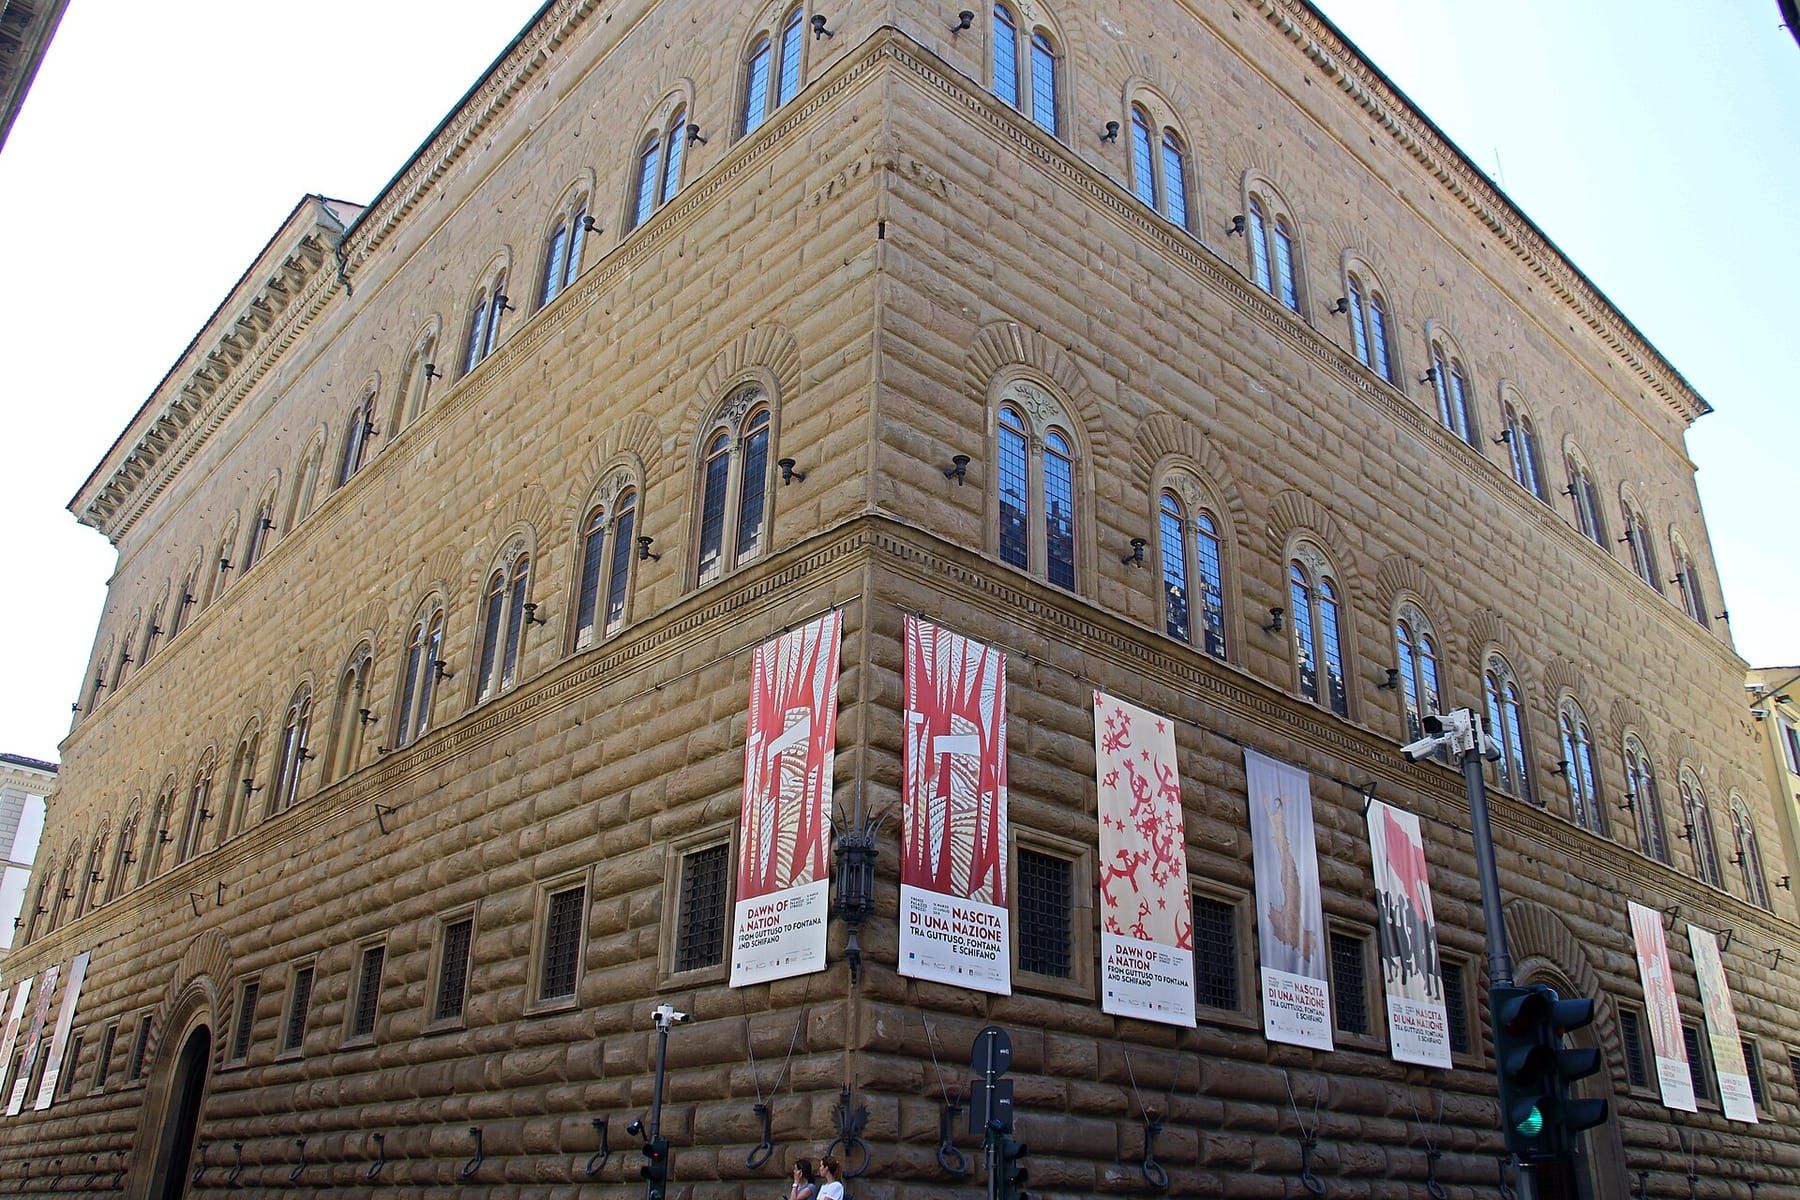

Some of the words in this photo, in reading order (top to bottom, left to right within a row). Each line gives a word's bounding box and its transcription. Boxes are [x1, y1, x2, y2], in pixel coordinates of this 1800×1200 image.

[747, 903, 774, 919] DAWN
[776, 900, 789, 912] OF
[952, 907, 1001, 928] NASCITA
[738, 931, 755, 942] FROM
[755, 926, 782, 938] GUTTUSO
[784, 923, 792, 932] TO
[793, 917, 821, 930] FONTANA
[739, 924, 745, 933] A
[747, 915, 780, 932] NATION
[910, 911, 921, 925] DI
[924, 915, 949, 932] UNA
[952, 922, 1001, 942] NAZIONE
[738, 941, 750, 950] AND
[751, 935, 780, 948] SCHIFANO
[910, 926, 925, 937] TRA
[927, 930, 965, 946] GUTTUSO,
[967, 939, 1001, 952] FONTANA
[952, 945, 957, 953] E
[959, 946, 996, 960] SCHIFANO
[1115, 944, 1143, 958] DAWN
[1145, 950, 1157, 961] OF
[1108, 955, 1114, 964] A
[1116, 956, 1150, 970] NATION
[1107, 965, 1125, 975] FROM
[1125, 968, 1154, 980] GUTTUSO
[1154, 974, 1162, 982] TO
[1163, 975, 1189, 987] FONTANA
[1269, 988, 1277, 998] DI
[1278, 990, 1294, 1001] UNA
[1295, 995, 1325, 1009] NAZIONE
[1294, 983, 1323, 997] NASCITA
